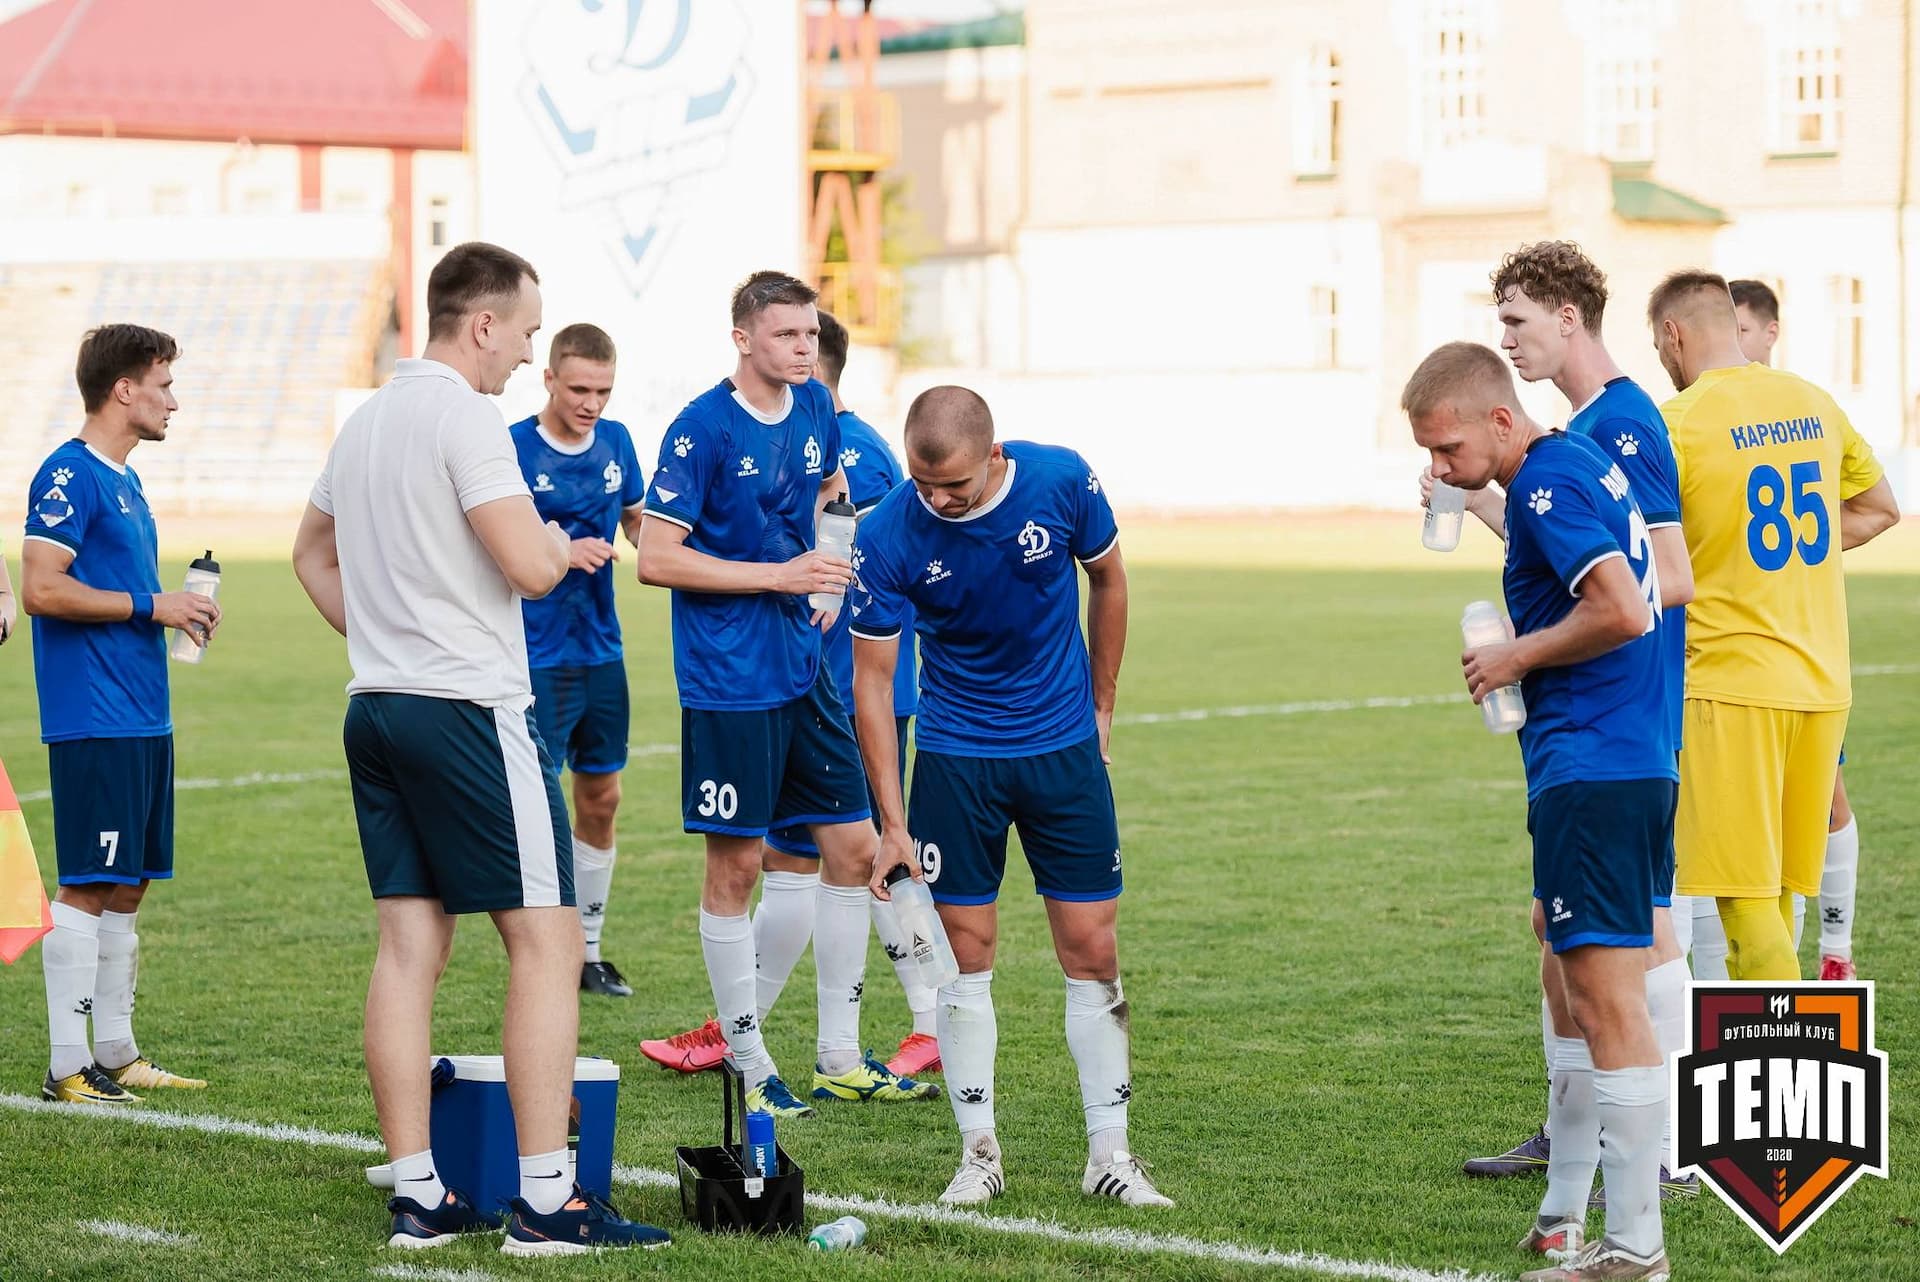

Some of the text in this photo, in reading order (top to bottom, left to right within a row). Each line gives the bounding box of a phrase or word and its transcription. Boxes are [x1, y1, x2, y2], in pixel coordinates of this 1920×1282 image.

[1730, 416, 1824, 450] КАРЮКИН
[1747, 460, 1831, 572] 85
[925, 570, 953, 585] KELME
[698, 779, 738, 819] 30
[100, 831, 119, 866] 7
